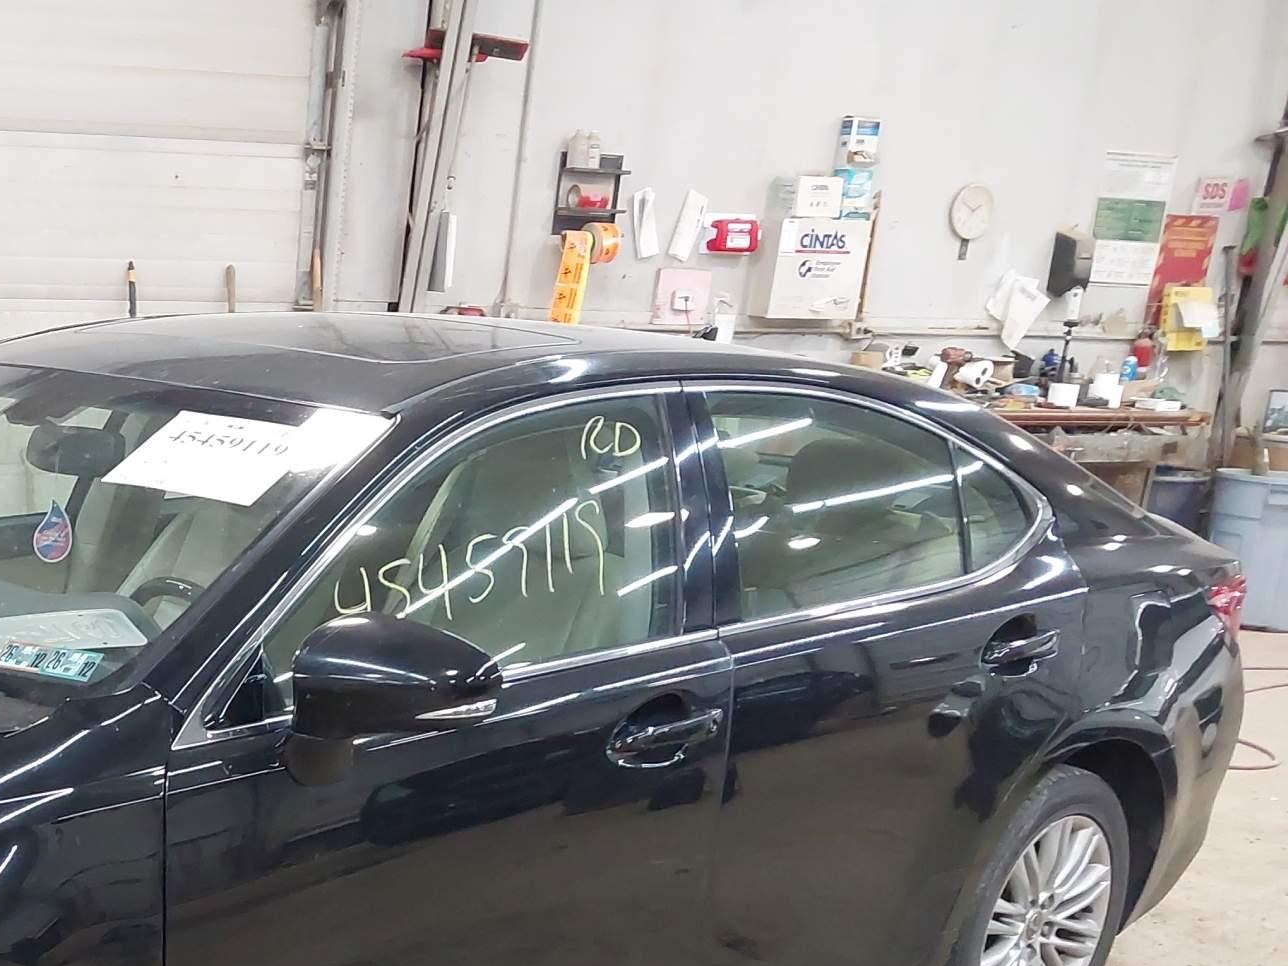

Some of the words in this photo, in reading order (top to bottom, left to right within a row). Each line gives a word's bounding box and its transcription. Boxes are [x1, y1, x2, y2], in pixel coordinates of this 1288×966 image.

[1202, 182, 1228, 200] SDS
[800, 228, 846, 249] CINTAS
[30, 651, 48, 668] 12
[45, 650, 66, 670] 26
[78, 660, 97, 677] 12
